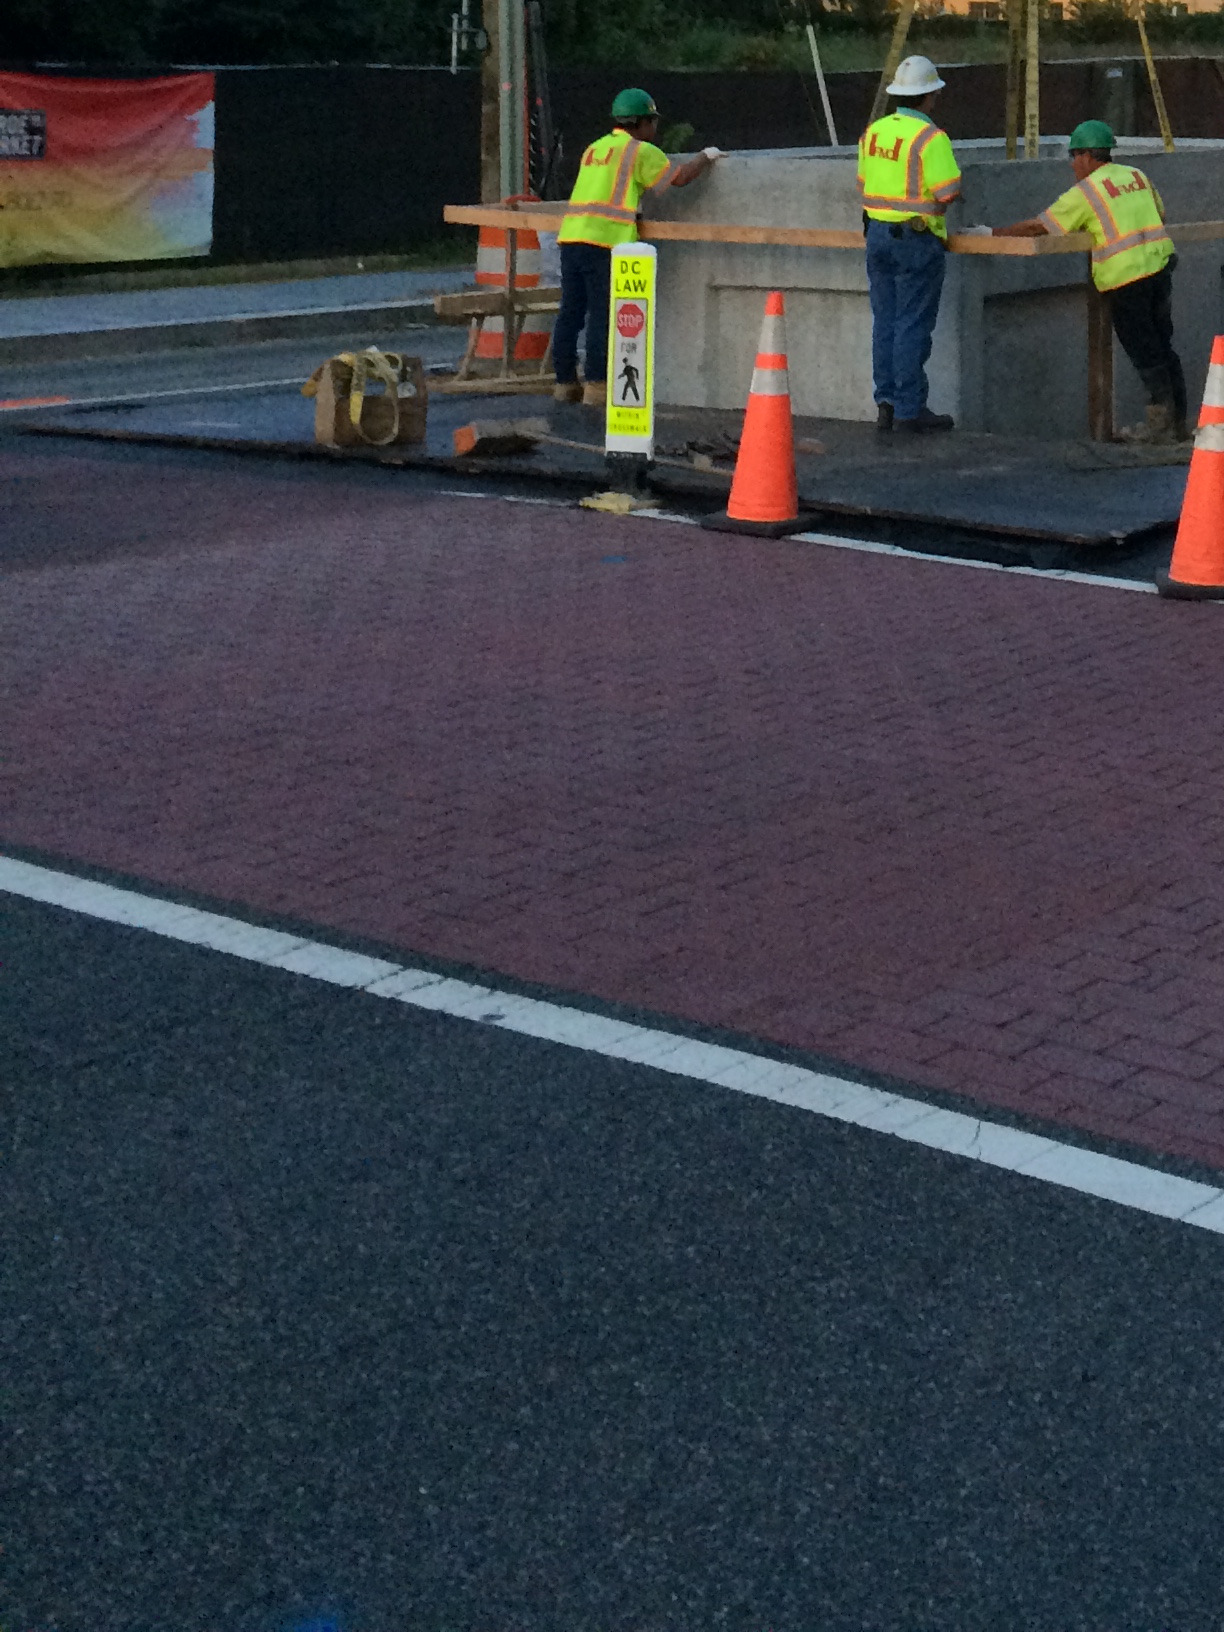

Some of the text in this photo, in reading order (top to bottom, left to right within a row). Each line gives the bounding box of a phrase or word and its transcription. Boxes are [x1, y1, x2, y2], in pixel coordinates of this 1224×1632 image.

[620, 260, 641, 274] DC
[615, 279, 647, 293] LAW
[618, 314, 643, 328] STOP
[620, 342, 637, 354] FOR
